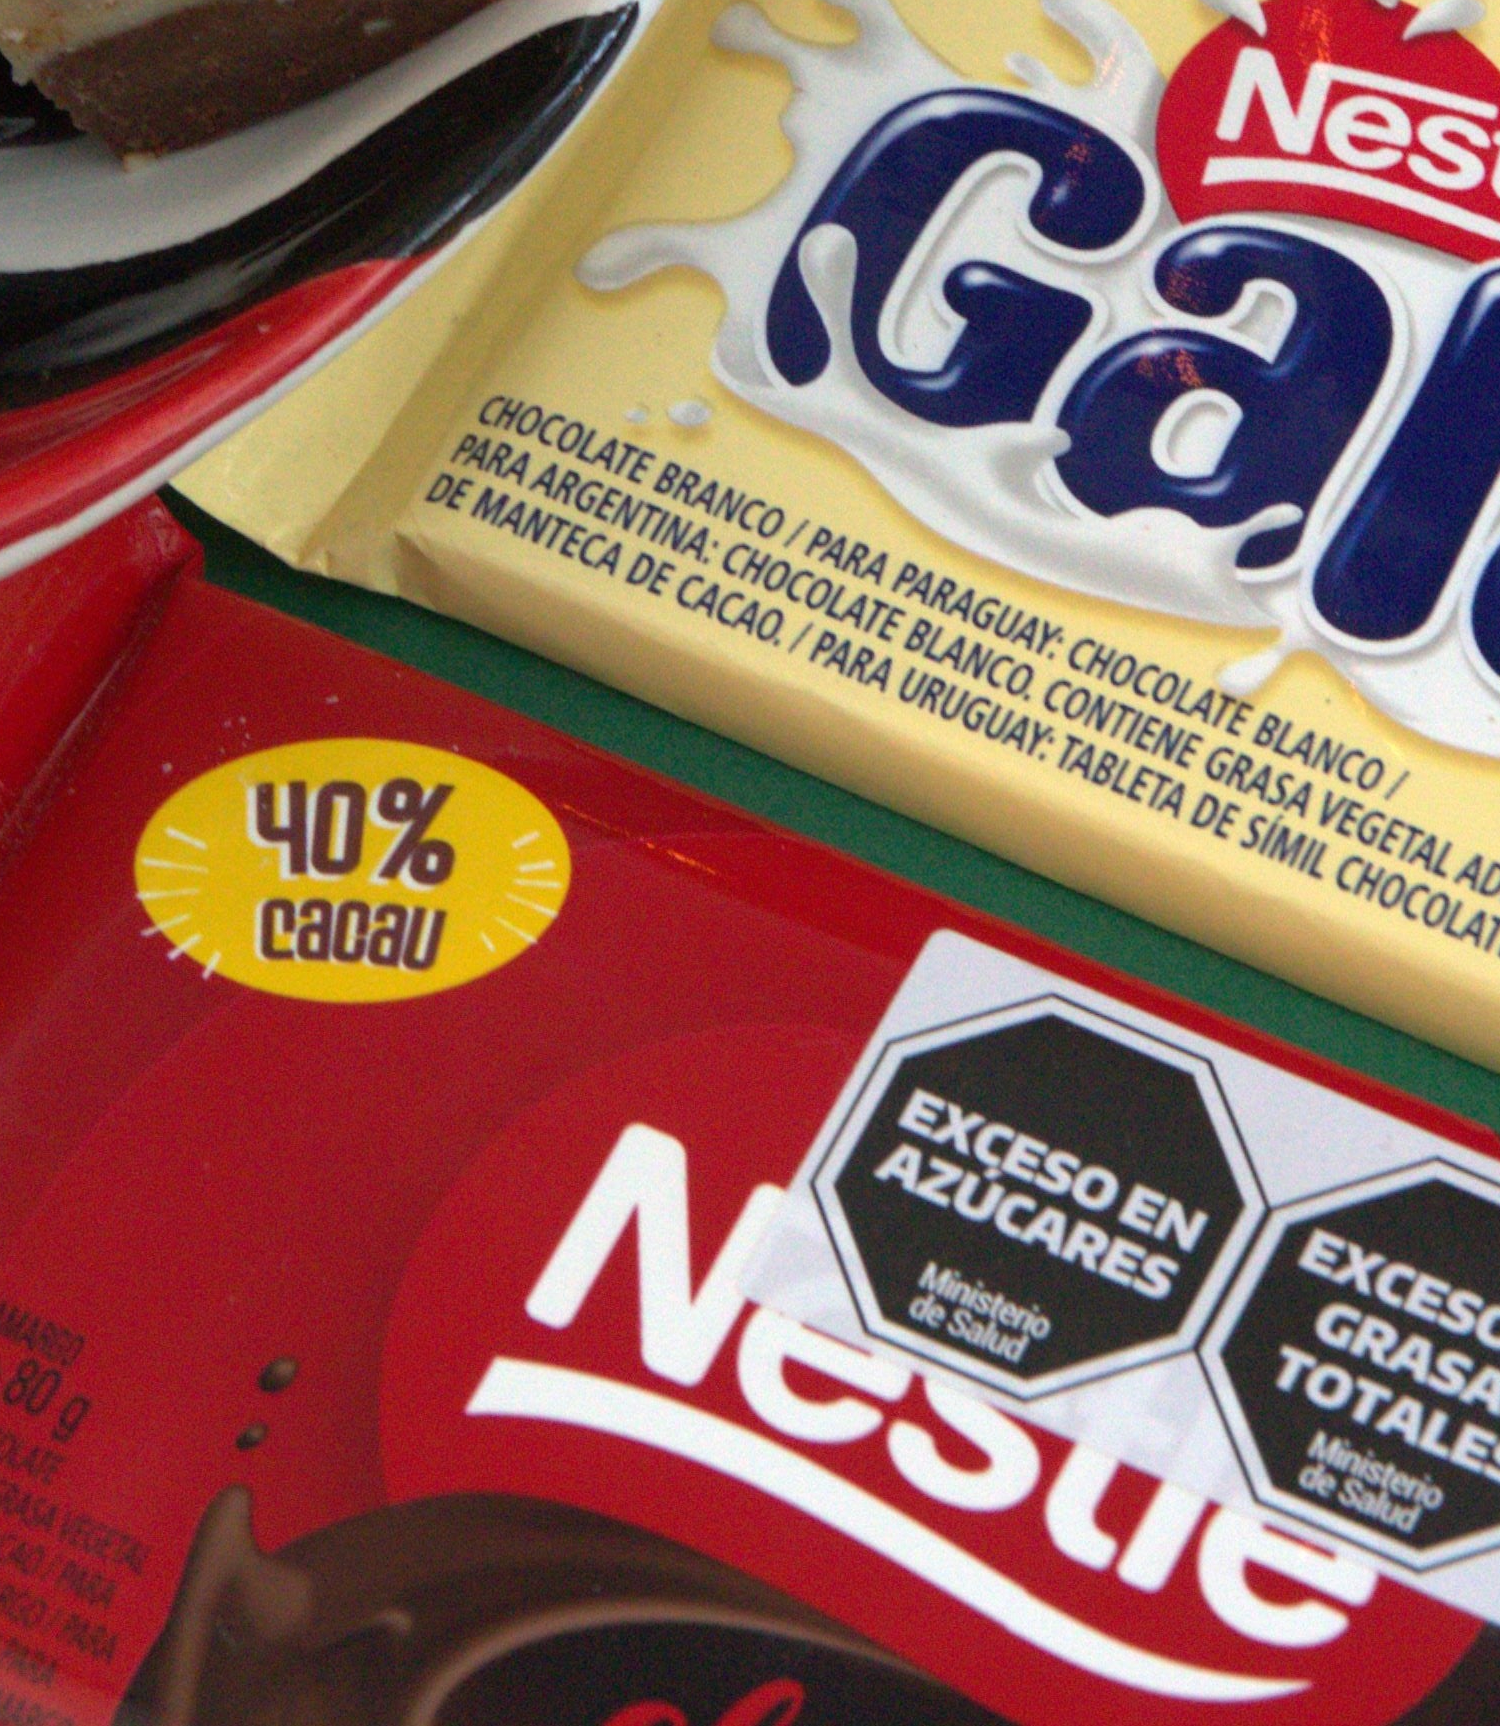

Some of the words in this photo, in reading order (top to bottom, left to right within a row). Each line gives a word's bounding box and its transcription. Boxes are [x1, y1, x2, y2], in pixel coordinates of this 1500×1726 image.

[478, 395, 656, 485] CHOCOLATE
[652, 461, 786, 539] BRANCO
[804, 526, 889, 586] PARA
[891, 562, 1064, 660] PARAGUAY:
[1067, 637, 1255, 737] CHOCOLATE
[1252, 712, 1385, 792] BLANCO
[425, 473, 474, 511] DE
[470, 486, 623, 576] MANTECA
[625, 552, 676, 596] DE
[675, 574, 785, 647] CACAO.
[809, 630, 893, 692] PARA
[898, 667, 1055, 761] URUGUAY:
[1058, 734, 1186, 819] TABLETA
[1189, 792, 1241, 840] DE
[1239, 814, 1328, 880] SÍMIL
[451, 433, 531, 486] PARA
[529, 462, 719, 565] ARGENTINA:
[721, 543, 907, 643] CHOCOLATE
[903, 617, 1035, 701] BLANCO.
[1043, 679, 1204, 769] CONTIENE
[1204, 746, 1313, 818] GRASA
[1319, 790, 1452, 879] VEGETAL
[246, 777, 456, 890] 40%
[875, 1144, 1179, 1299] AZÚCARES
[899, 1089, 1119, 1210] EXCESO
[1119, 1185, 1208, 1251] EN
[909, 1292, 946, 1327] de
[947, 1308, 1030, 1362] Salud
[918, 1262, 1051, 1339] Ministerio
[1, 1358, 63, 1417] 80
[51, 1394, 93, 1444] g
[1298, 1463, 1337, 1497] de
[1338, 1477, 1422, 1532] Salud
[1307, 1431, 1444, 1509] Ministerio
